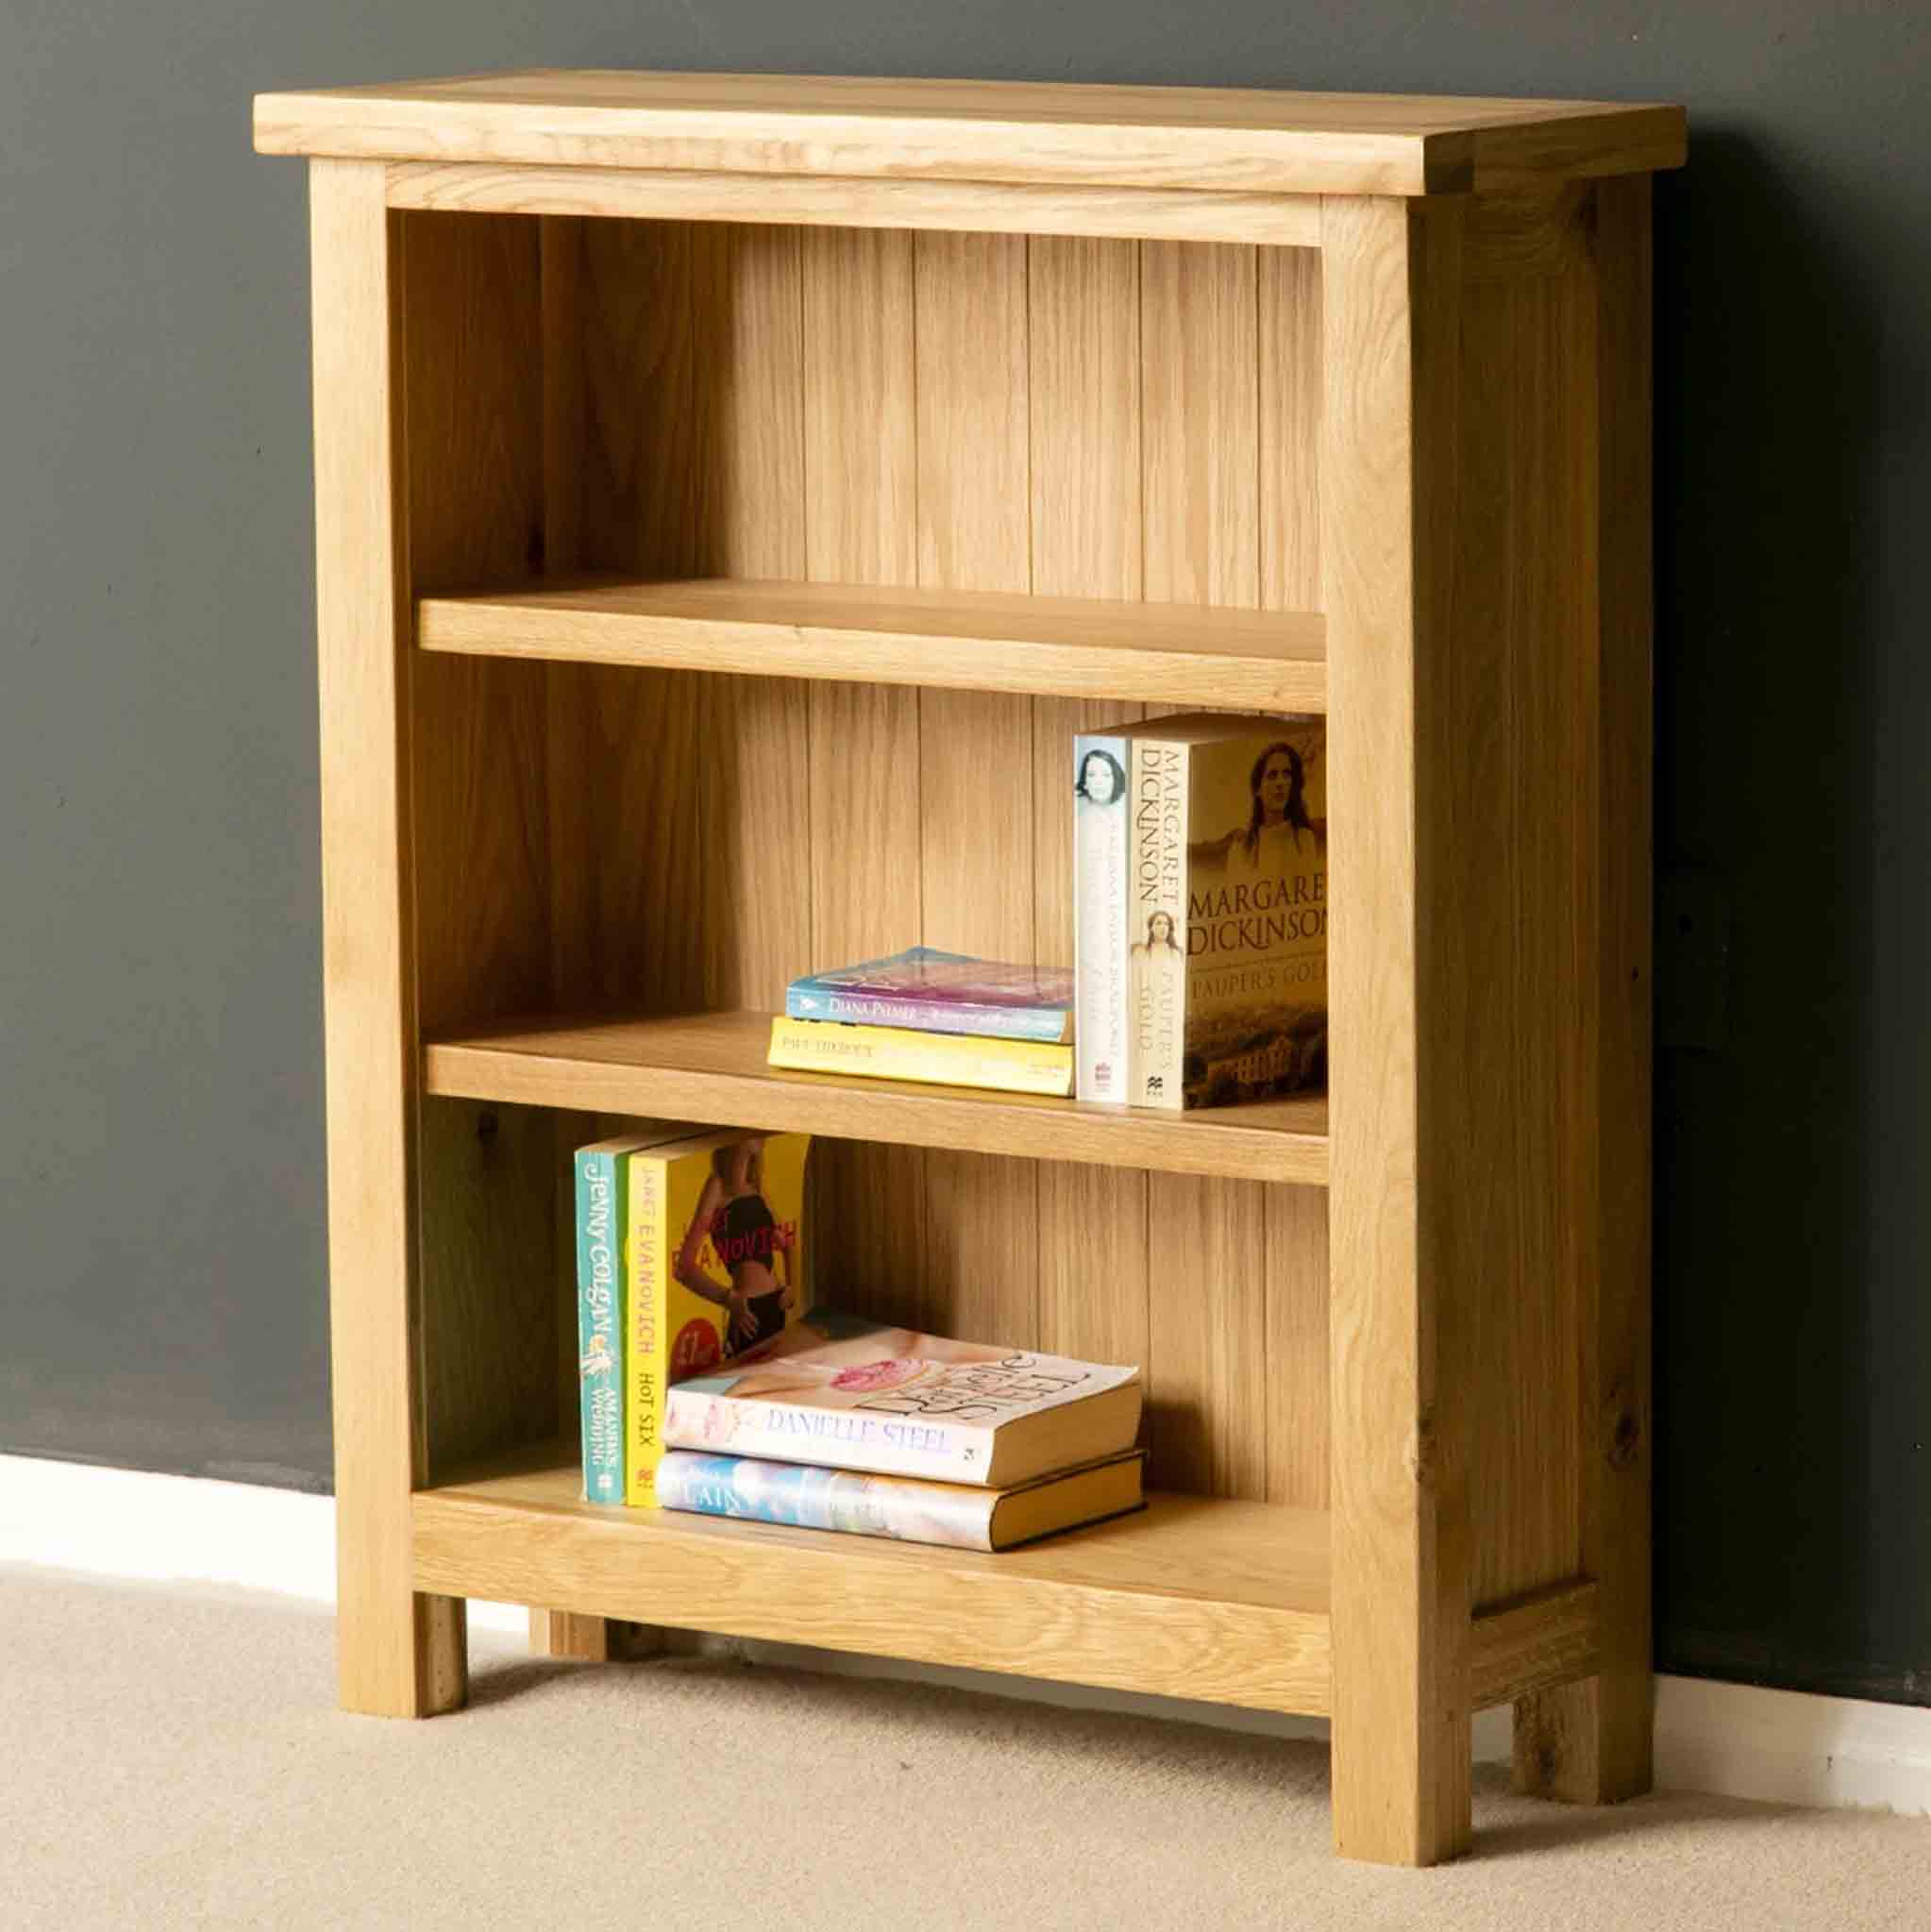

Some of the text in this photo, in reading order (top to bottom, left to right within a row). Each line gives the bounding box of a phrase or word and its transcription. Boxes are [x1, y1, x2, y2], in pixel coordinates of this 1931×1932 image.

[1136, 748, 1162, 907] DICKINSON
[1162, 749, 1180, 906] MARGARET
[638, 1224, 656, 1354] EVANOVICH
[638, 1414, 656, 1448] SIX
[766, 1409, 951, 1453] DANIELLE STEEL
